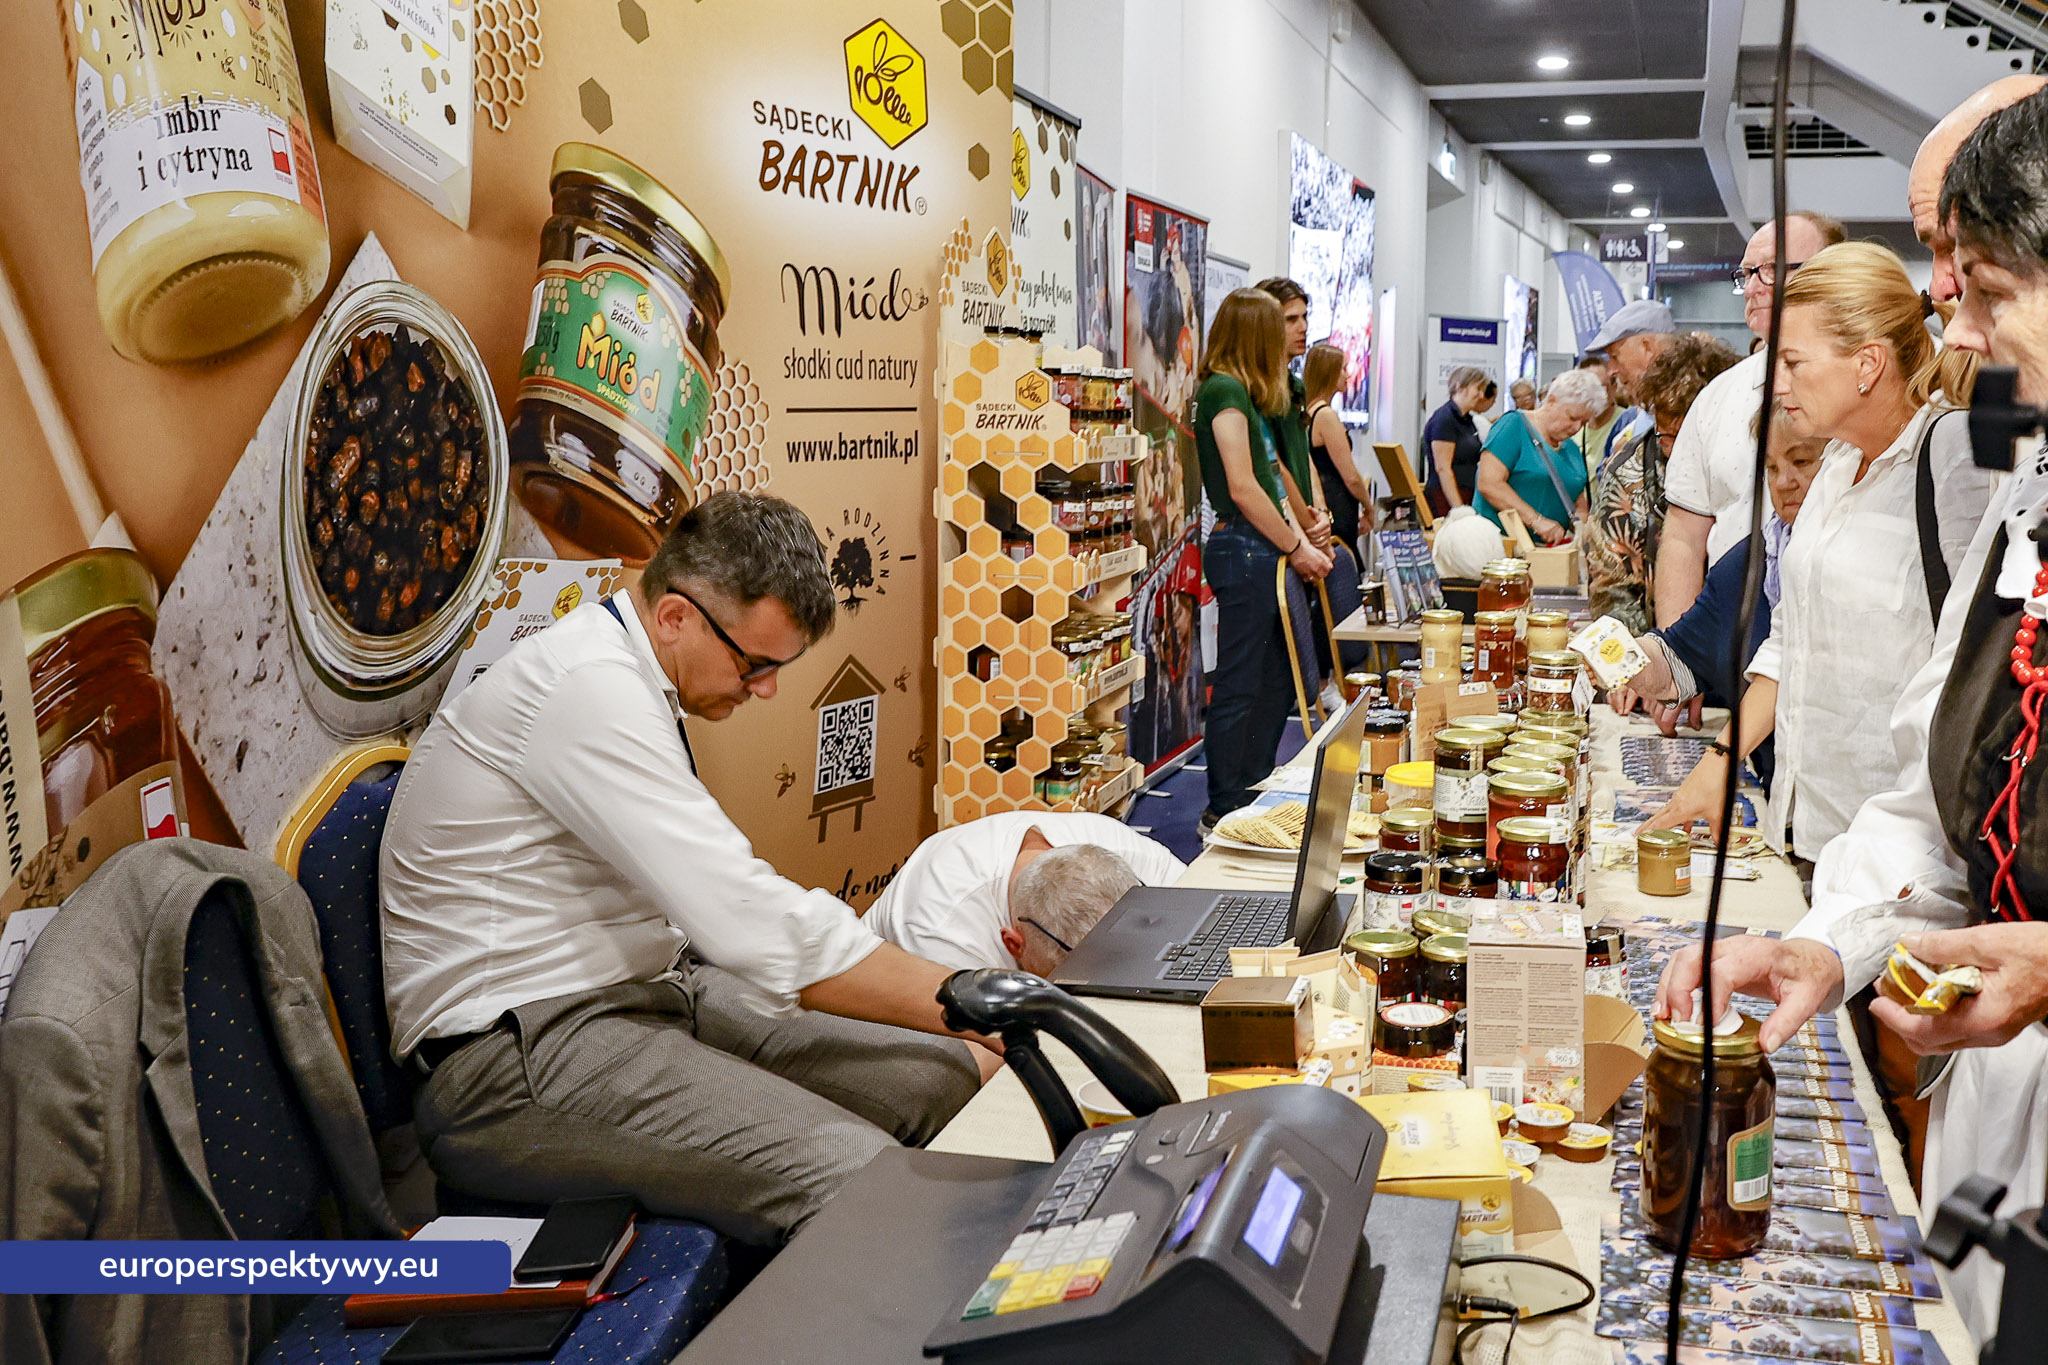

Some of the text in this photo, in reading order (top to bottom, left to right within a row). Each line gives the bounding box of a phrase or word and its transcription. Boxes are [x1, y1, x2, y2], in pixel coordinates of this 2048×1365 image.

[154, 94, 222, 141] imbir
[754, 101, 852, 142] SĄDECKI
[136, 150, 148, 191] i
[157, 143, 253, 188] cytryna
[759, 140, 920, 213] BARTNIK
[781, 262, 913, 339] Miód
[962, 280, 987, 296] SĄDECKI
[610, 309, 648, 341] BARTNIK
[962, 299, 1005, 328] BARTNIK
[576, 322, 661, 413] Miód
[783, 347, 918, 388] słodki cud natury
[975, 403, 1017, 413] SĄDECKI
[975, 413, 1044, 430] BARTNIK
[786, 429, 919, 465] www.bartnik.pl
